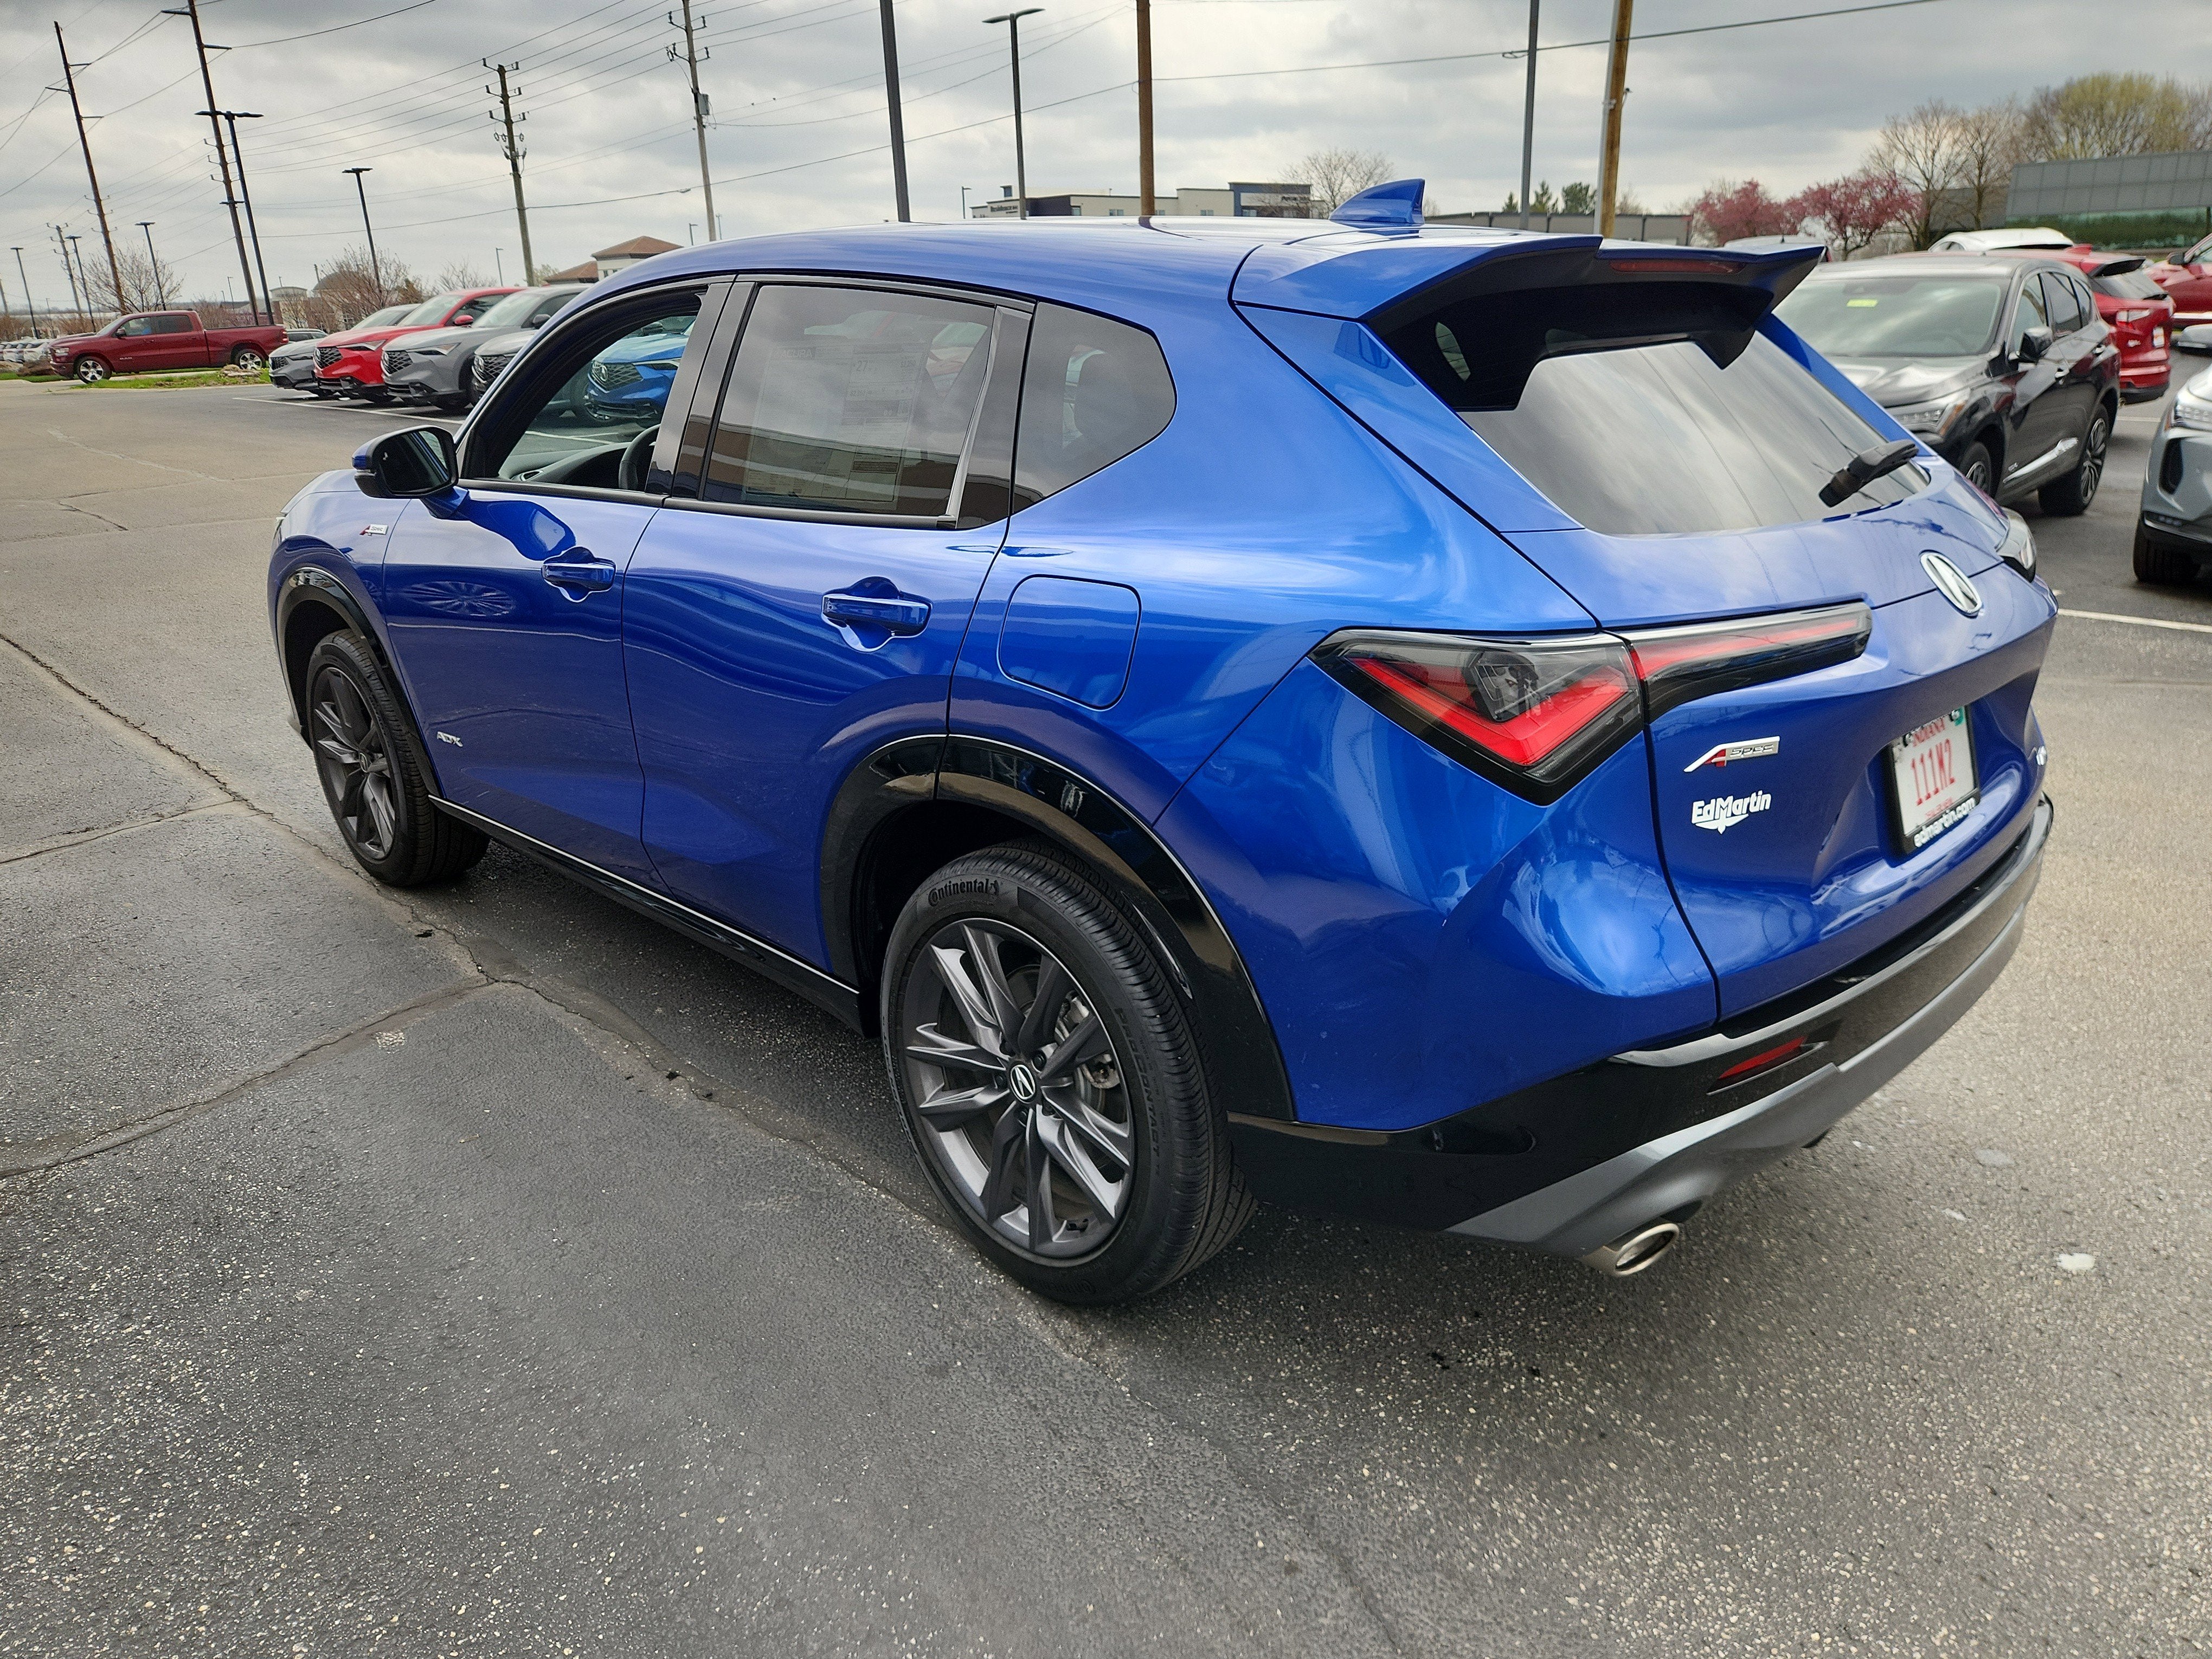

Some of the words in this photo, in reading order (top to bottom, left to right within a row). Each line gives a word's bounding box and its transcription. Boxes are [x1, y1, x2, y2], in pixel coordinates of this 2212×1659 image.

[436, 731, 464, 748] ADX
[1913, 796, 1976, 848] edmartin.com
[928, 878, 989, 907] Continental
